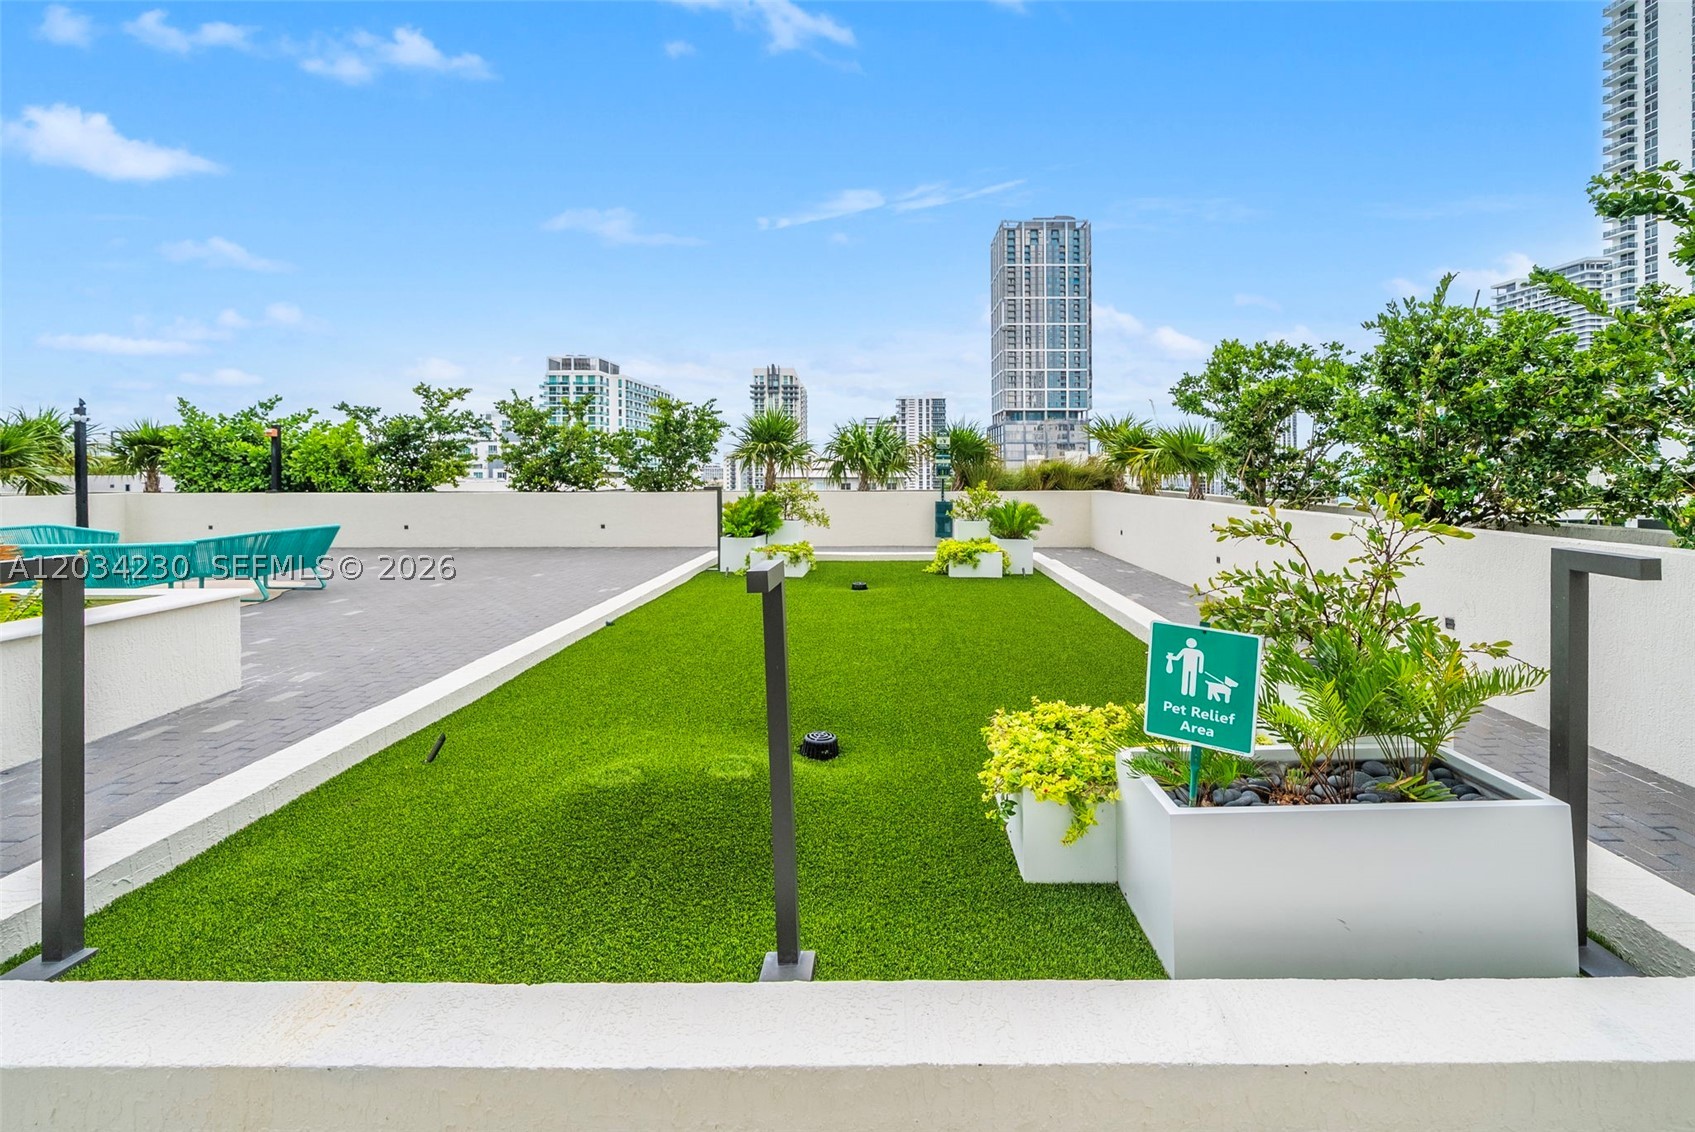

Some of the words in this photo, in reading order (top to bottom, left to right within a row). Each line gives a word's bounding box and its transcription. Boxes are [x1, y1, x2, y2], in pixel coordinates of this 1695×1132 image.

[1163, 701, 1187, 715] Pet
[1191, 706, 1236, 725] Relief
[1180, 720, 1214, 737] Area
